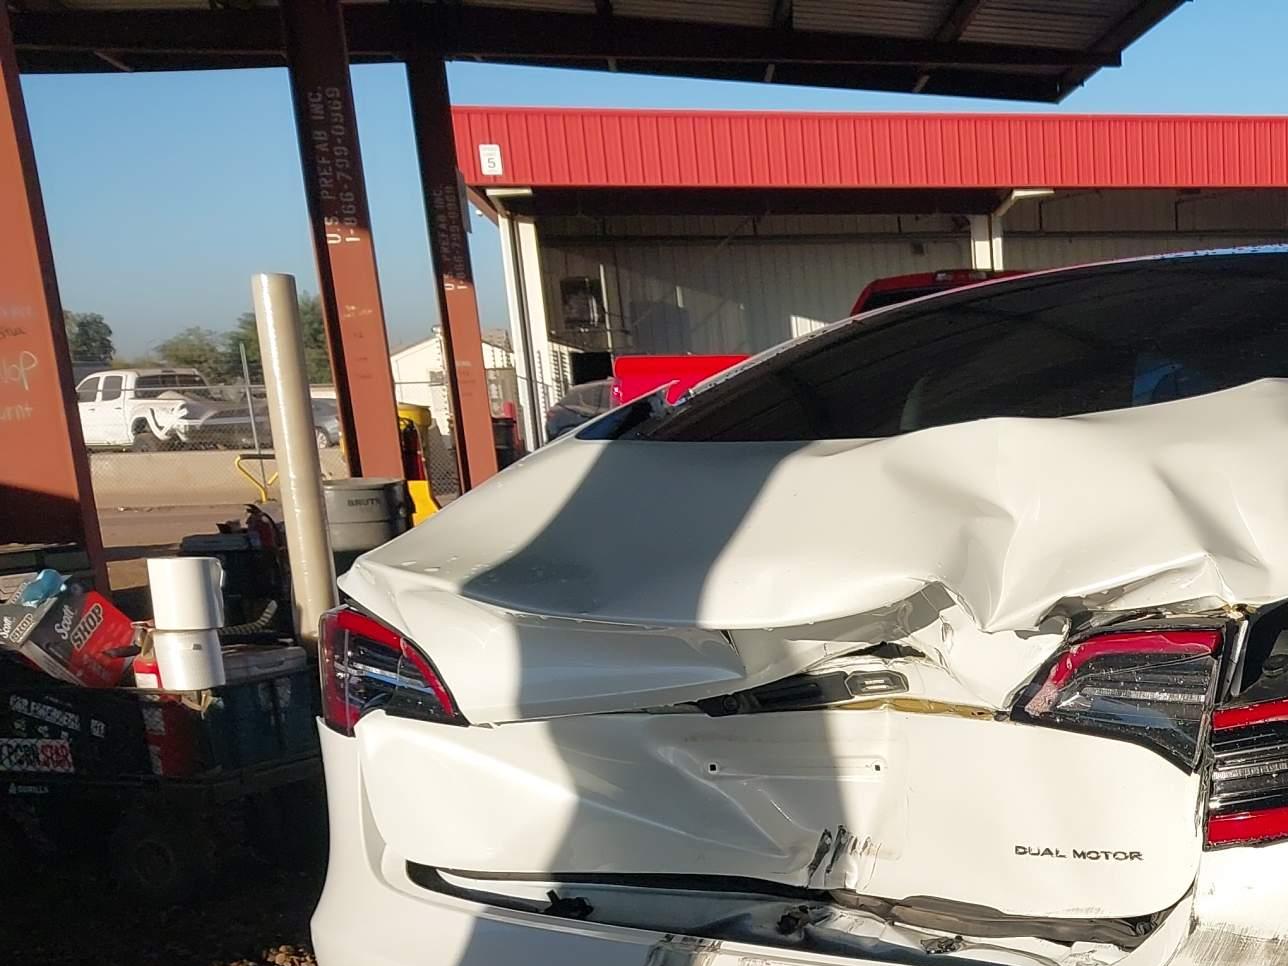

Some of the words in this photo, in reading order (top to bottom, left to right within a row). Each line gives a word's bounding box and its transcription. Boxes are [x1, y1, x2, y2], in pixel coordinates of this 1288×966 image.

[307, 86, 325, 120] INC.
[311, 131, 336, 200] PREFAB
[487, 157, 497, 169] 5
[324, 211, 342, 245] U.S.
[10, 613, 34, 642] SHOP
[71, 603, 103, 650] SHOP
[1014, 845, 1067, 858] DUAL
[1072, 848, 1144, 861] MOTOR
